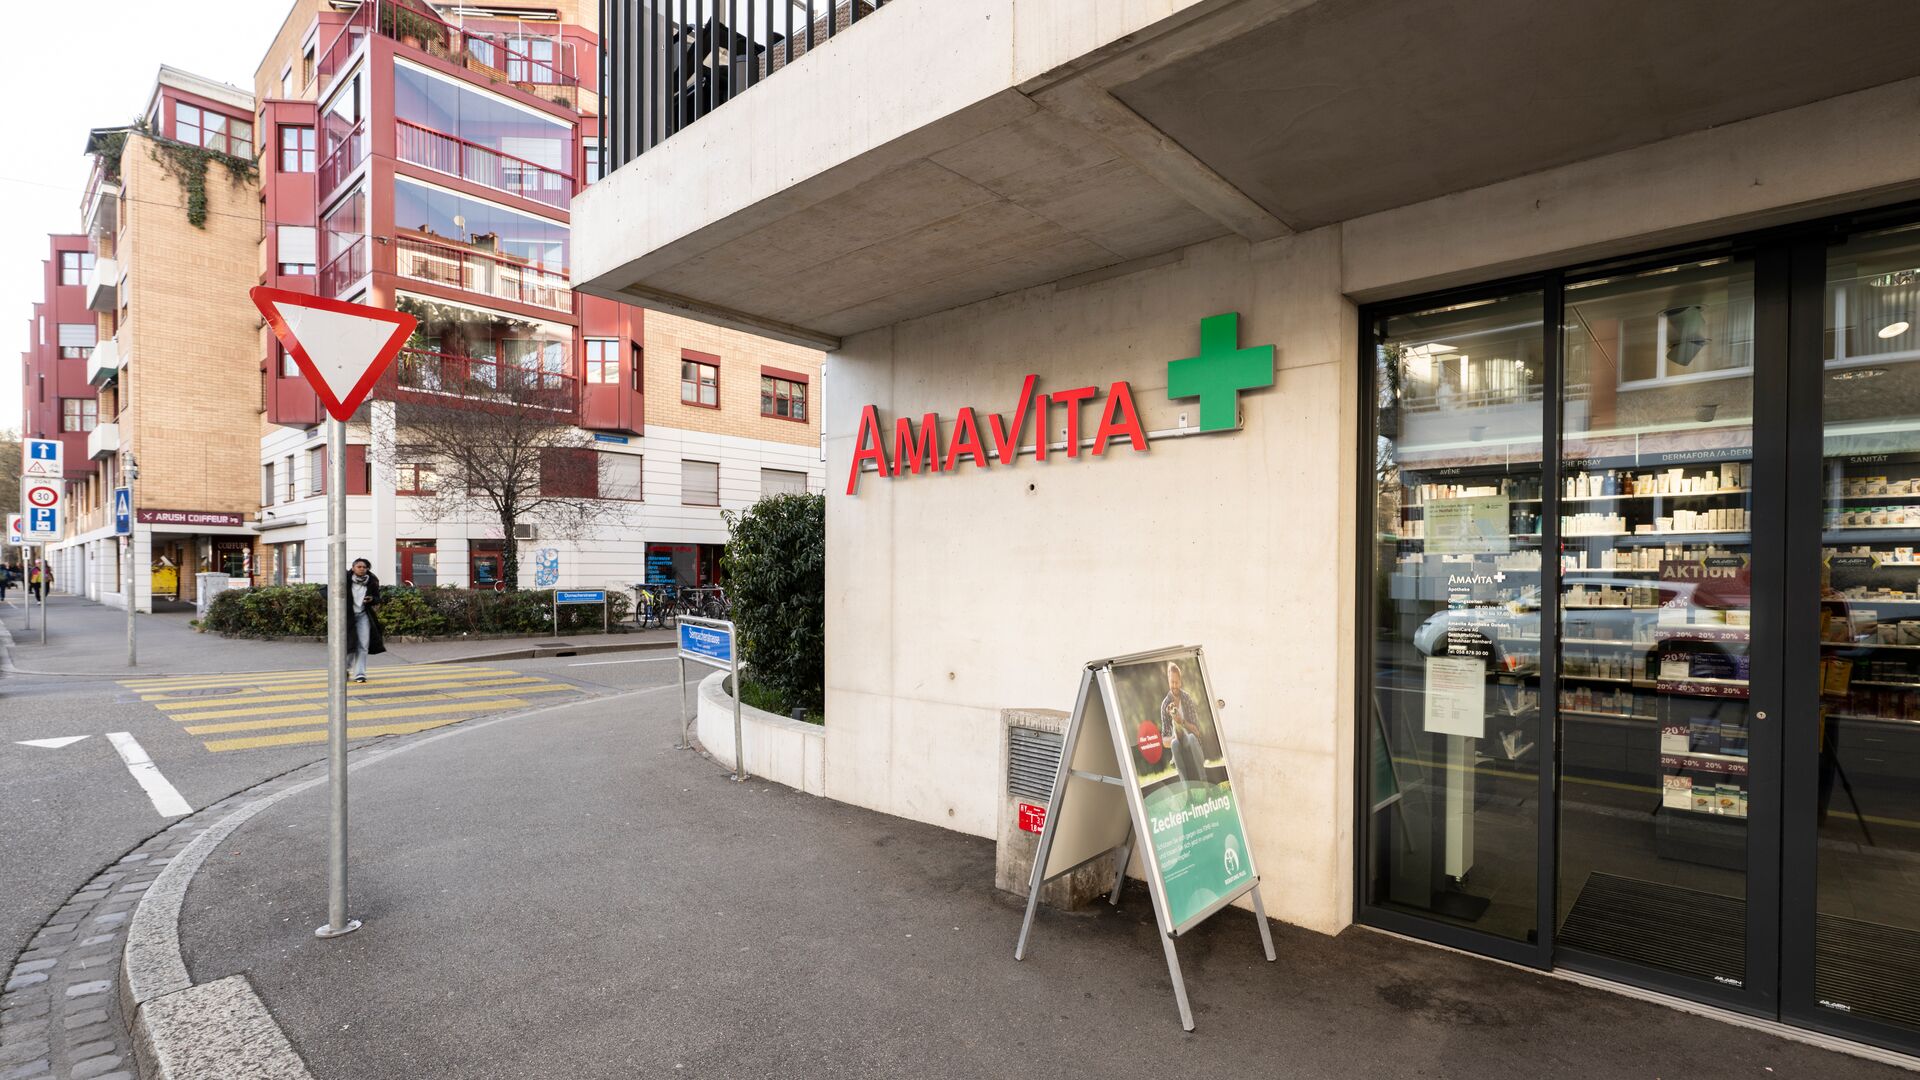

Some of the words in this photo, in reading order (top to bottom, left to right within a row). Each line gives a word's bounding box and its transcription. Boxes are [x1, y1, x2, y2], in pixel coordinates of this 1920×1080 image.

[846, 374, 1148, 496] AMAVITA
[1662, 450, 1715, 461] DERMAFORA
[1850, 454, 1888, 463] SANITÄT
[1577, 459, 1601, 467] POSAY
[36, 493, 50, 501] 30
[37, 509, 50, 521] P
[155, 513, 186, 522] ARUSH
[188, 514, 228, 523] COIFFEUR
[1663, 565, 1737, 578] AKTION
[1448, 574, 1493, 585] AMAVITA
[1728, 764, 1745, 772] 20%
[1150, 795, 1231, 834] Zecken-Impfung
